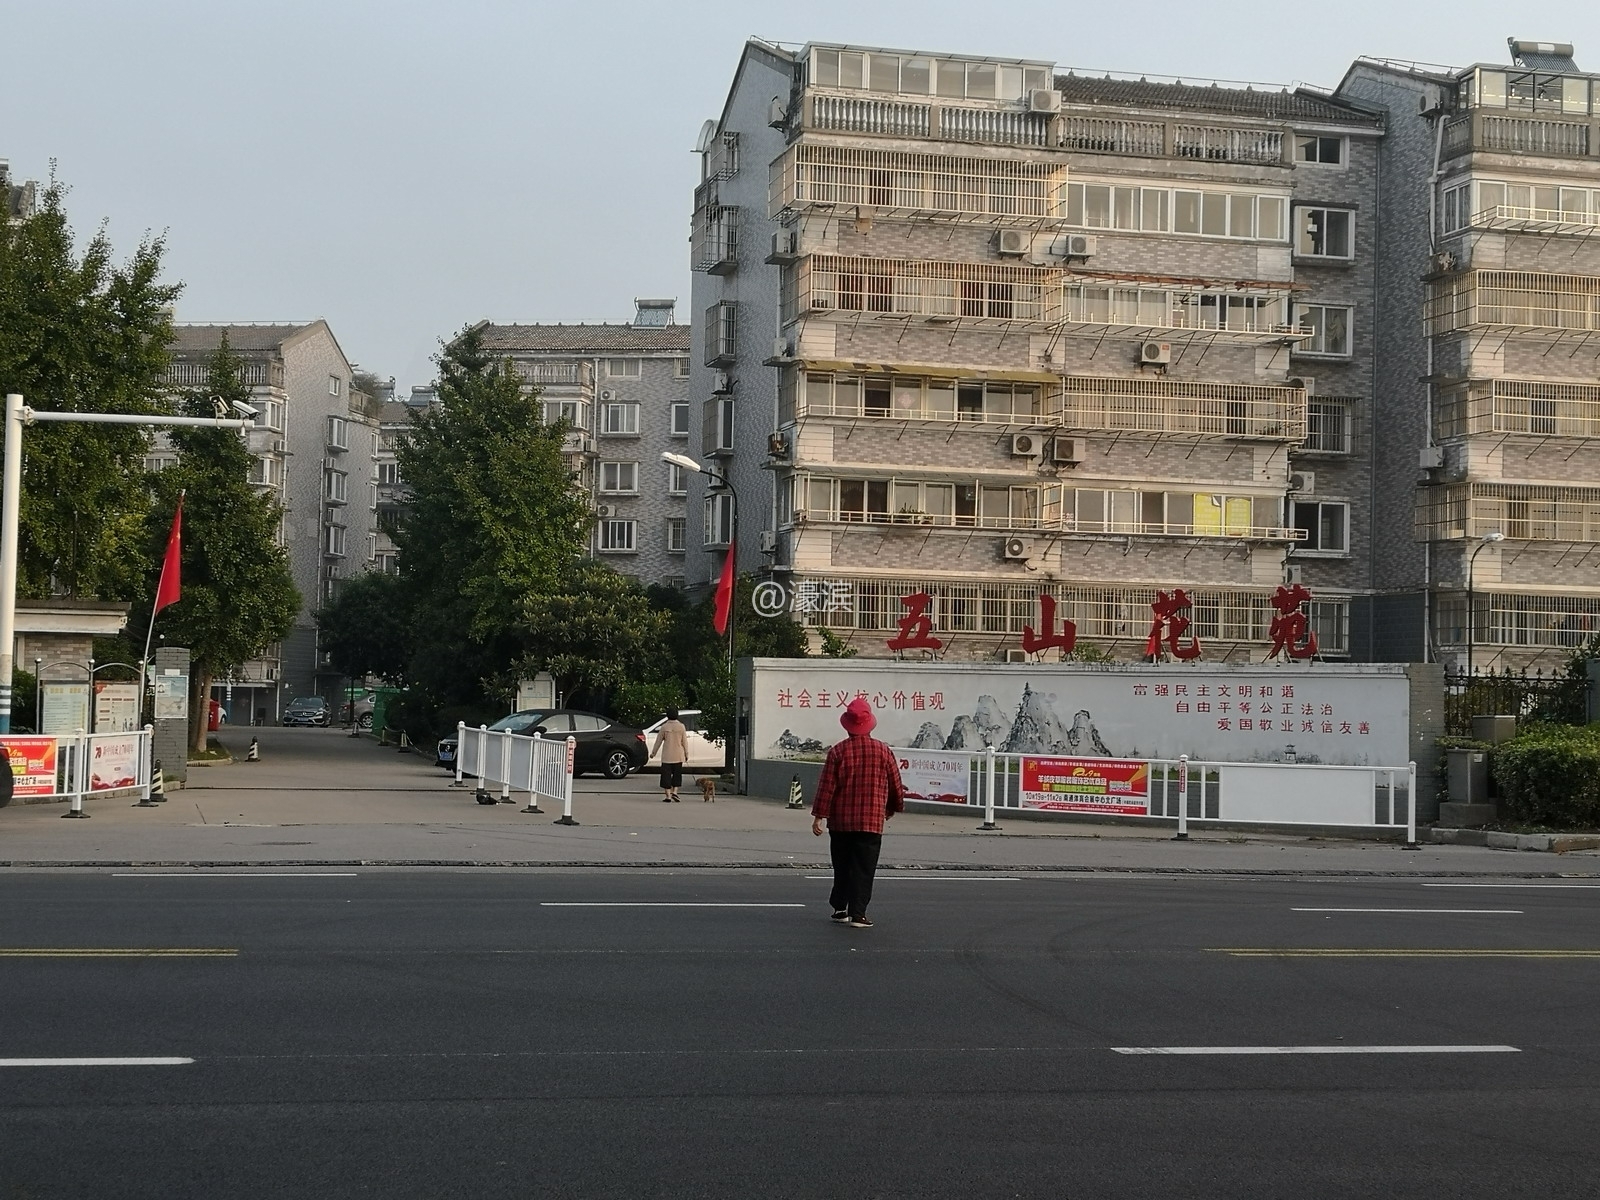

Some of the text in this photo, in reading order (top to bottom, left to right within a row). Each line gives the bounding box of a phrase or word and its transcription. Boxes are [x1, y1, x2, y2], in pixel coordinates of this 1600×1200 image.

[887, 584, 1318, 659] 五山花苑
[1133, 684, 1294, 698] 富强民主文明和谐
[1176, 702, 1333, 716] 自由平等公正法治
[1217, 718, 1370, 735] 爱国敬业诚信友善
